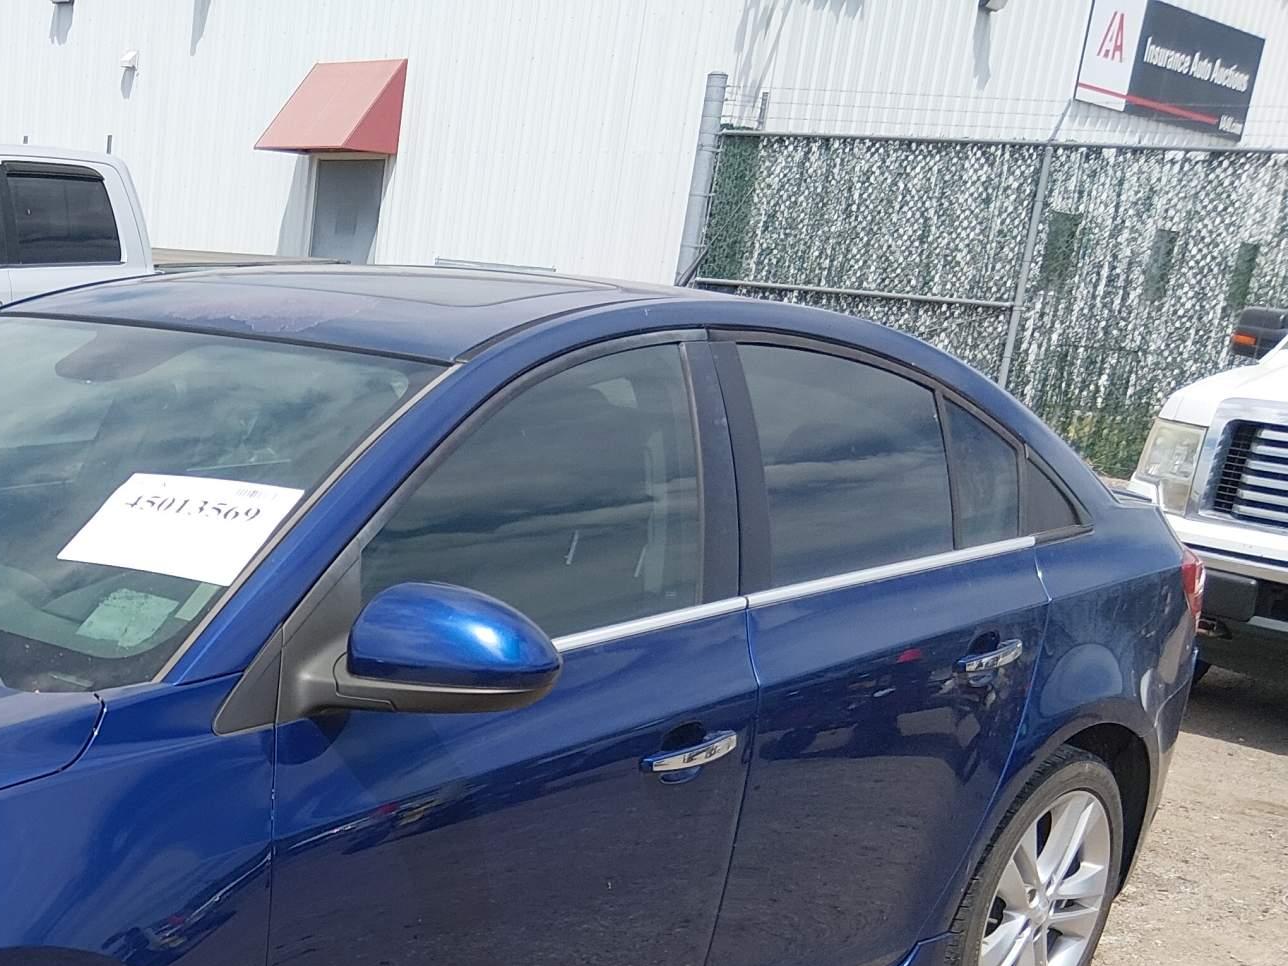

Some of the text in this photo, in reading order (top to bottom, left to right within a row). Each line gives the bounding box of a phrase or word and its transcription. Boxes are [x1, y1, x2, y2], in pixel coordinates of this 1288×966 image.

[1143, 35, 1251, 93] Insurance Auto Auctions
[125, 495, 261, 522] 45013569
